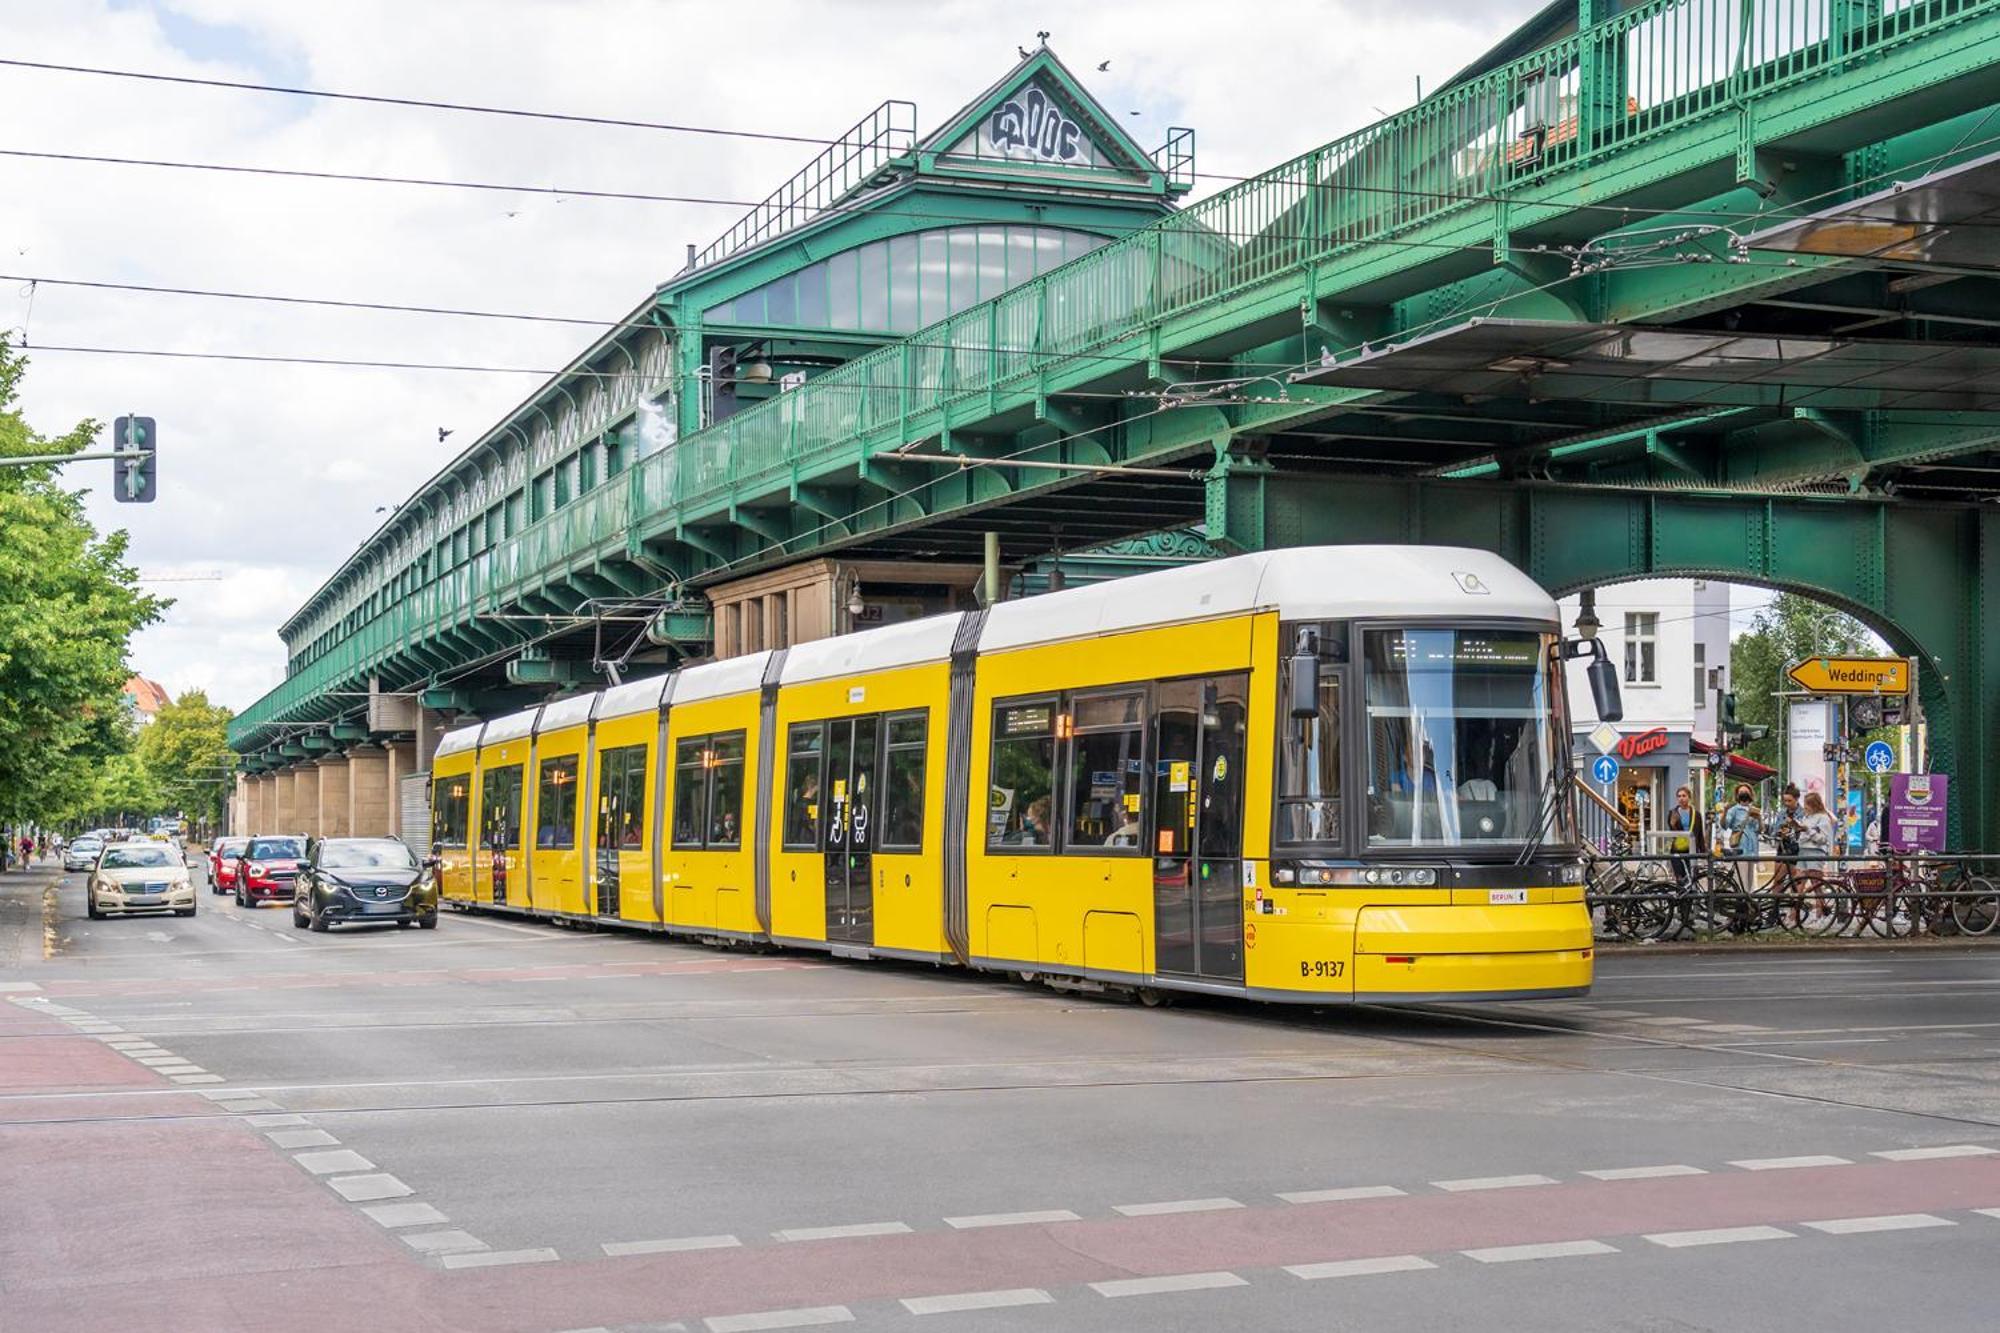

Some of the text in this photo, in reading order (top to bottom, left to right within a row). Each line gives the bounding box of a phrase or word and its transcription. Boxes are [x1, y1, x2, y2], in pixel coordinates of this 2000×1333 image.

[1828, 669, 1884, 685] Wedding
[1617, 726, 1669, 760] Viani
[1301, 961, 1345, 977] B-9137
